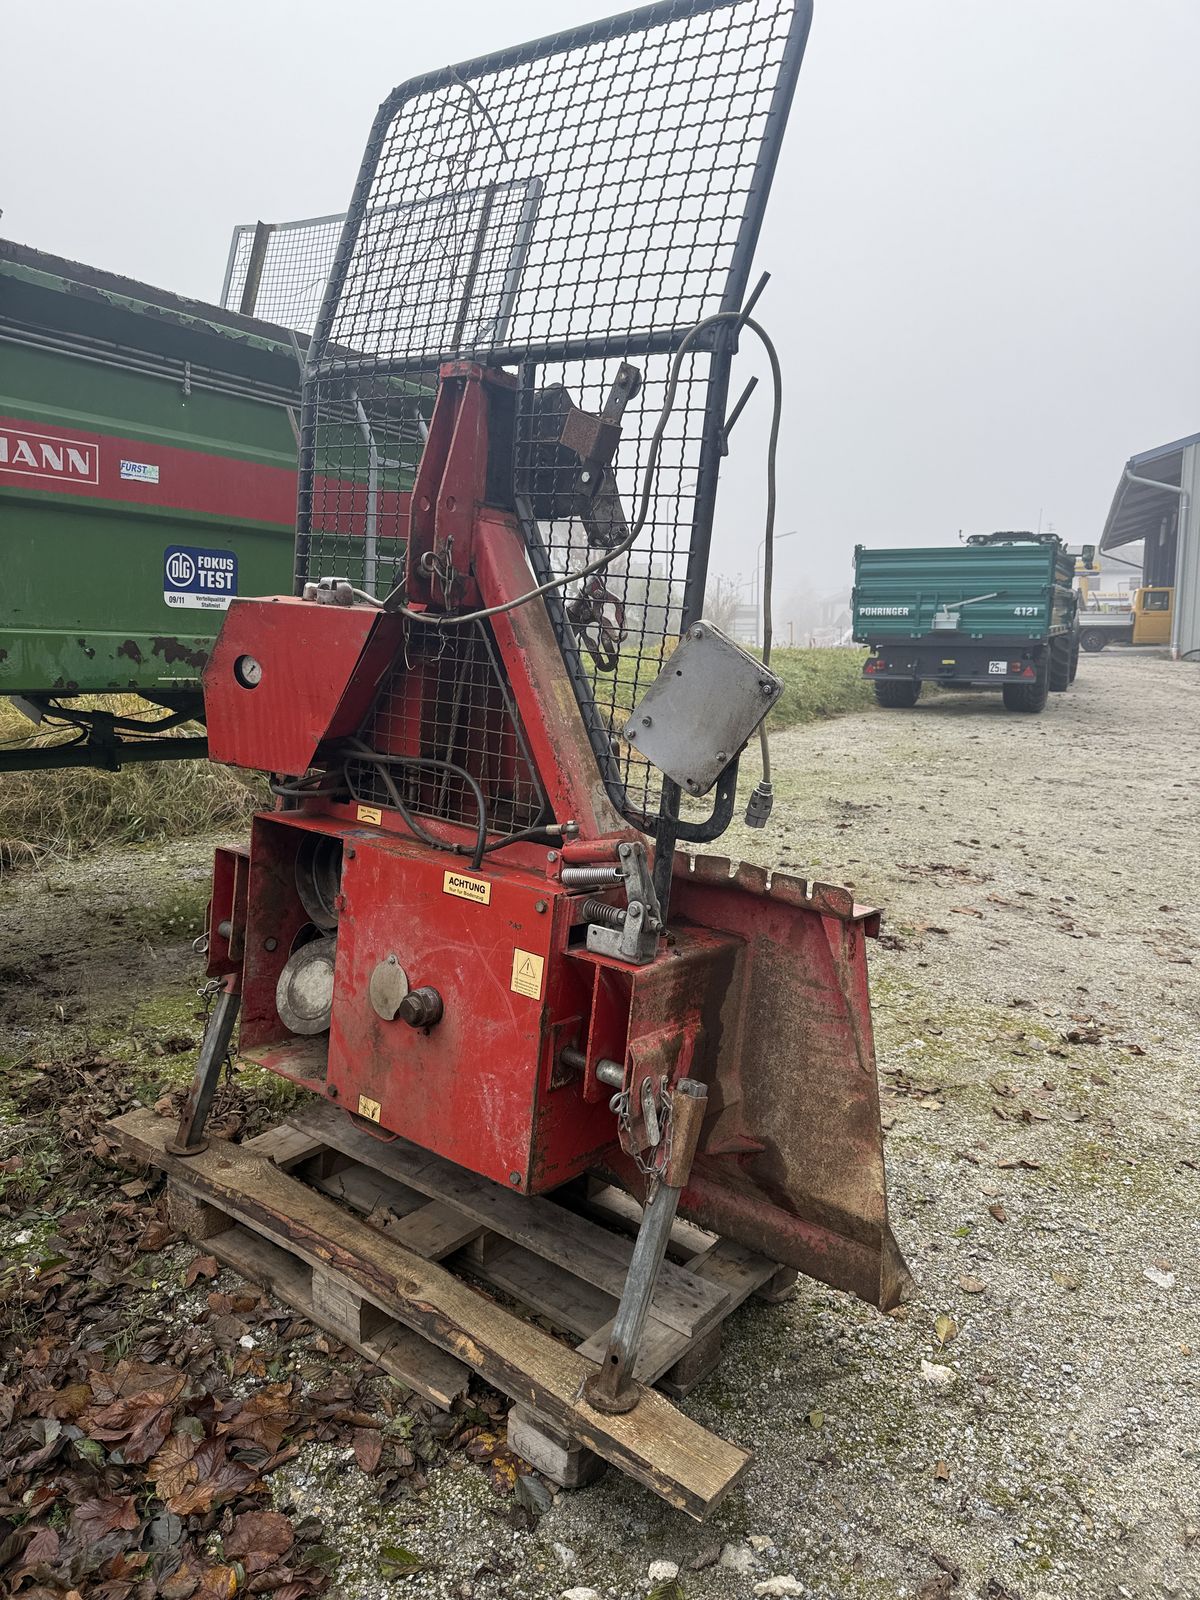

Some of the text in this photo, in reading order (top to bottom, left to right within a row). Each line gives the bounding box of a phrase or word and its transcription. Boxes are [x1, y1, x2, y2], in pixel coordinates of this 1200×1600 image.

[198, 555, 234, 571] FOKUS
[198, 570, 234, 590] TEST
[168, 595, 185, 604] 09/11
[1014, 606, 1039, 616] 4121
[990, 662, 1000, 673] 25
[449, 877, 486, 894] ACHTUNG
